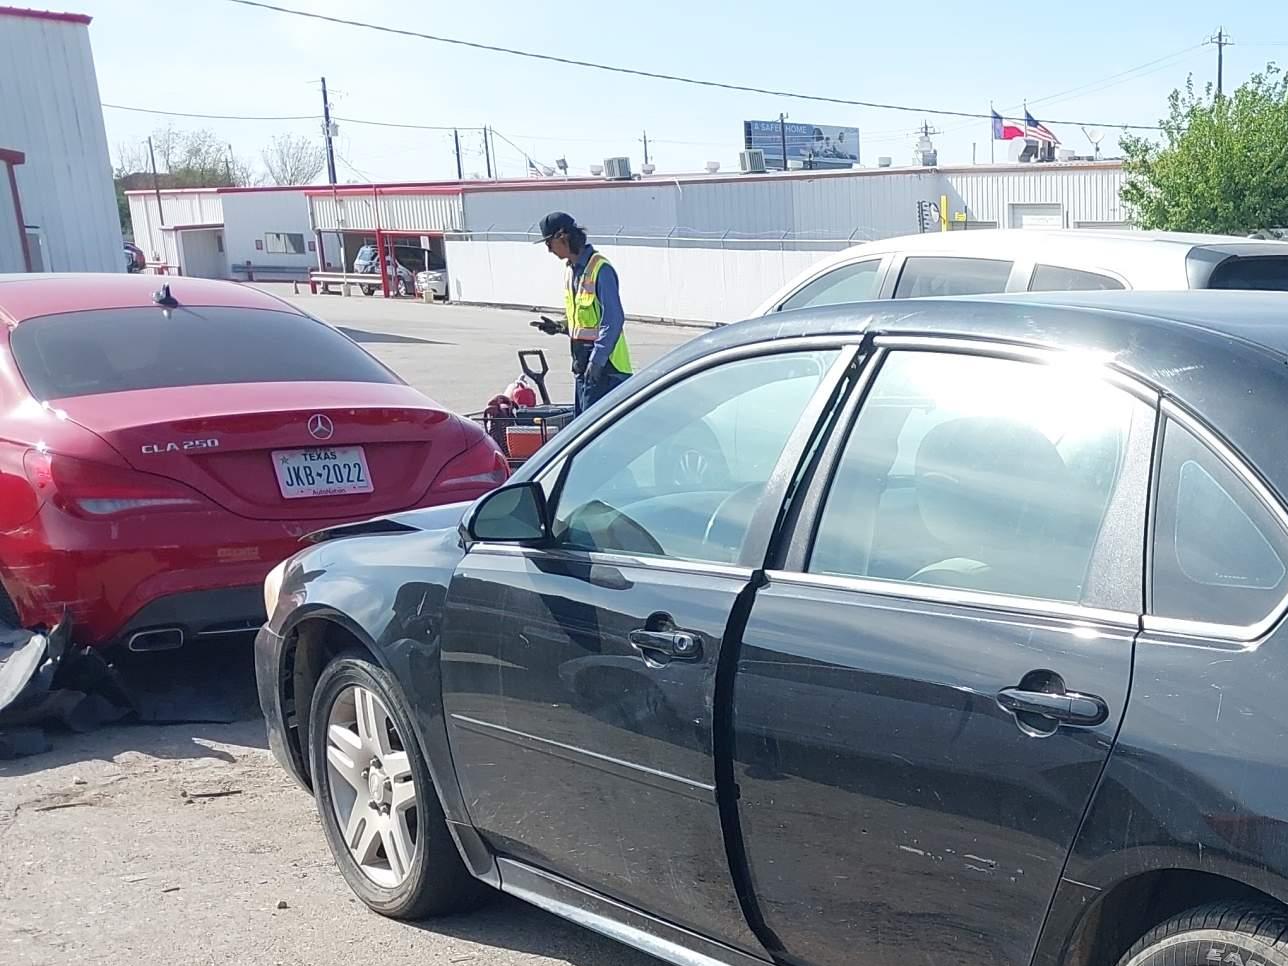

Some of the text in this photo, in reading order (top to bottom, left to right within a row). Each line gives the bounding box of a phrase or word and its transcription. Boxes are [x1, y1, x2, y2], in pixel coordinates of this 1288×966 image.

[785, 125, 807, 134] HOME
[141, 438, 219, 454] CLA 250
[302, 451, 337, 461] TEXAS
